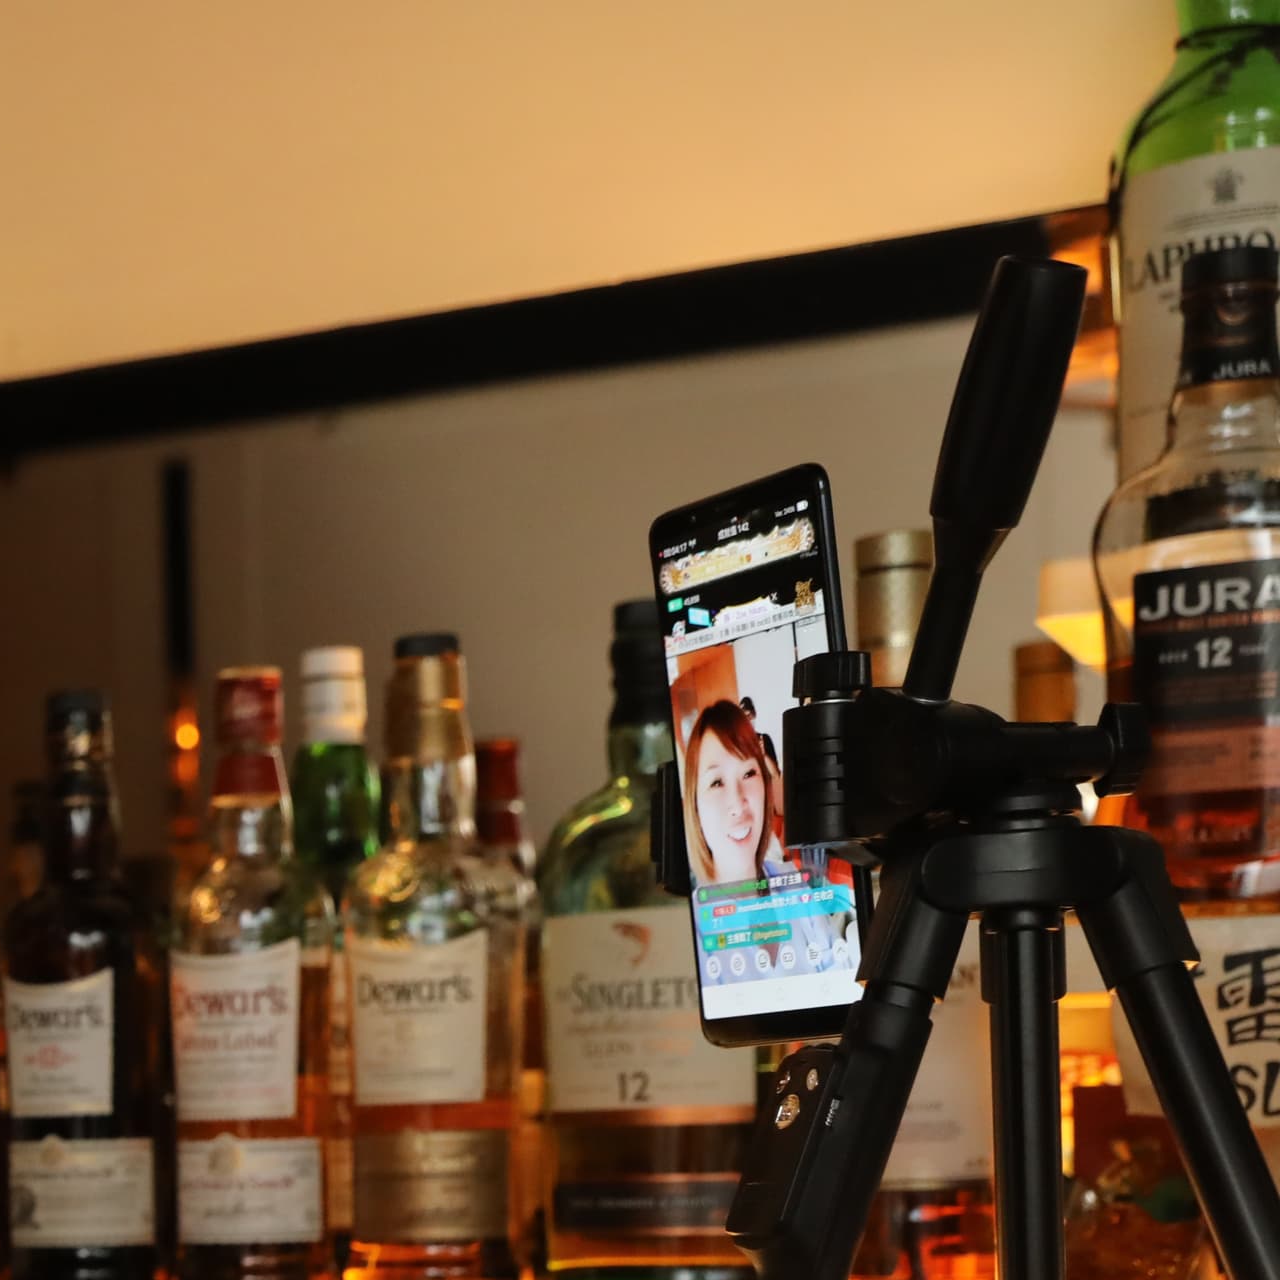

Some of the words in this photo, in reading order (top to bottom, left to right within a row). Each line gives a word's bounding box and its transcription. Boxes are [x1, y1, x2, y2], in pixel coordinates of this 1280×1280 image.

[1214, 360, 1271, 380] JURA
[1195, 636, 1233, 669] 12
[617, 1071, 652, 1103] 12
